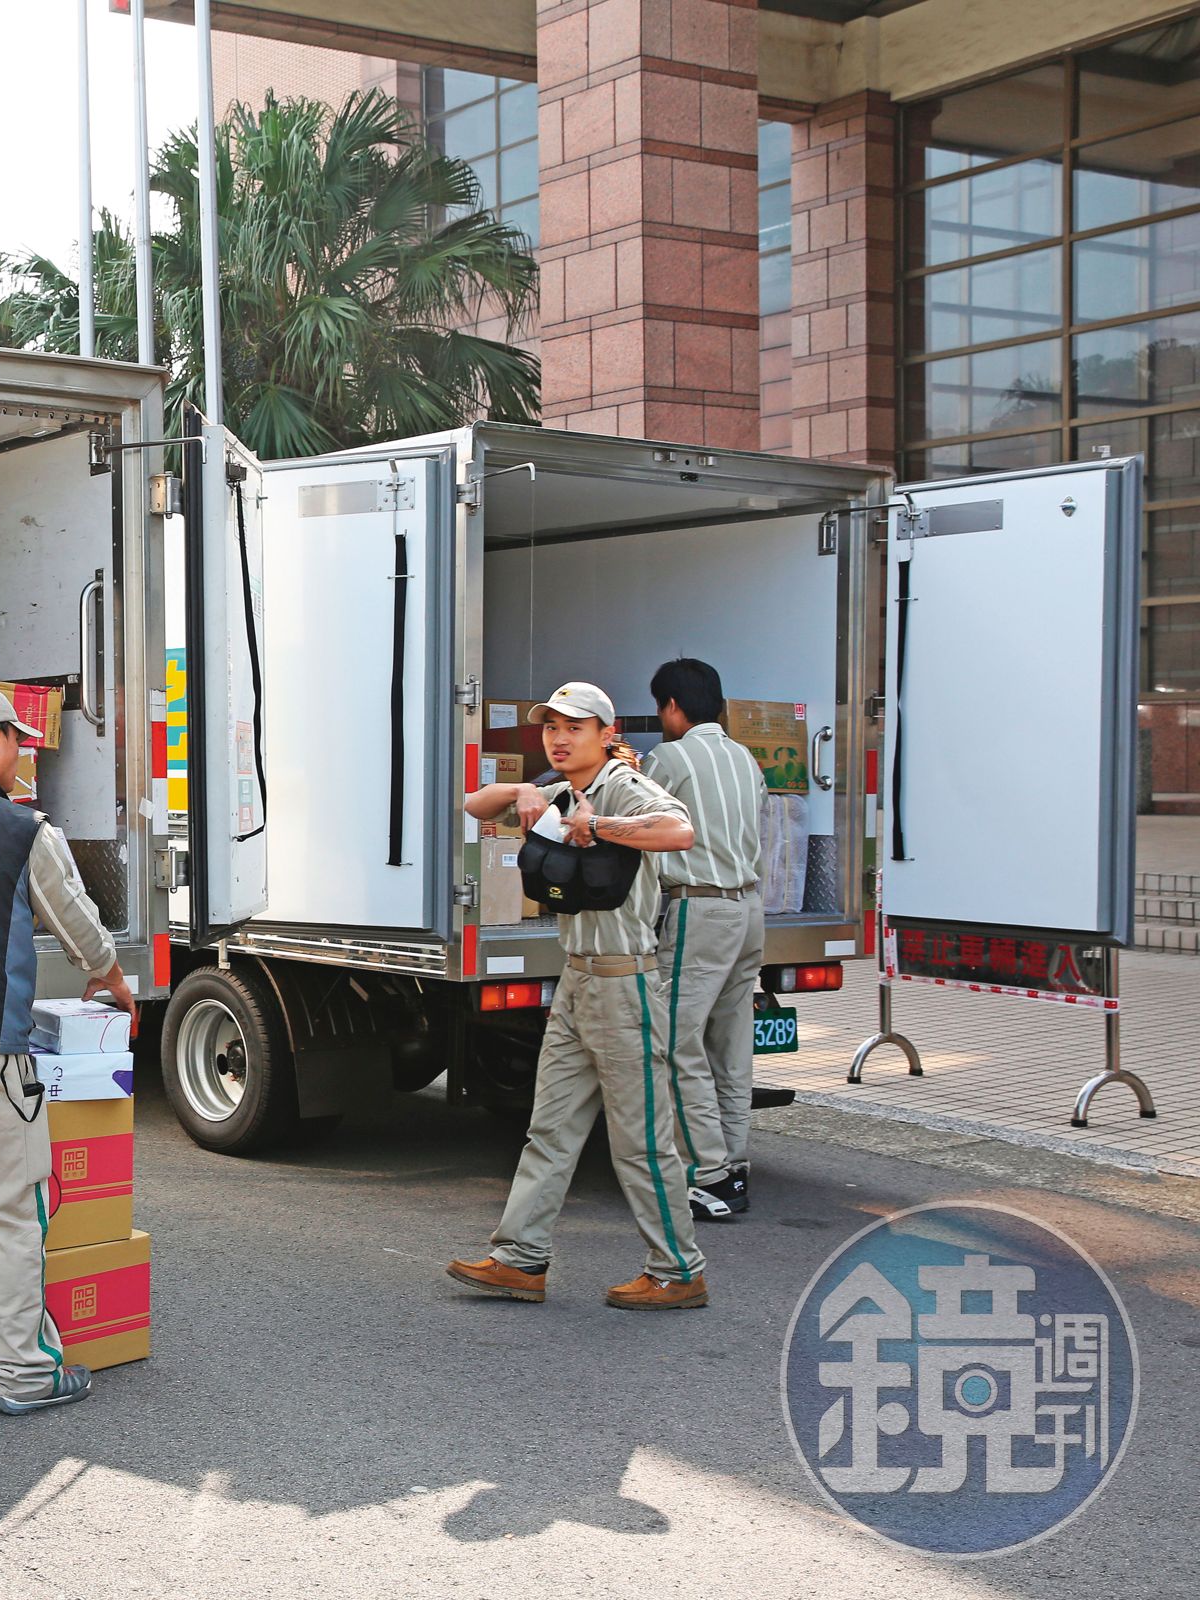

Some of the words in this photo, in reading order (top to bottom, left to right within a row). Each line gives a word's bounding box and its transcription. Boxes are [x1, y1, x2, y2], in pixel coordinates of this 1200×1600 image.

[901, 929, 1082, 981] 禁止車輛進入
[753, 1018, 796, 1047] 3289
[47, 1066, 63, 1101] 中心
